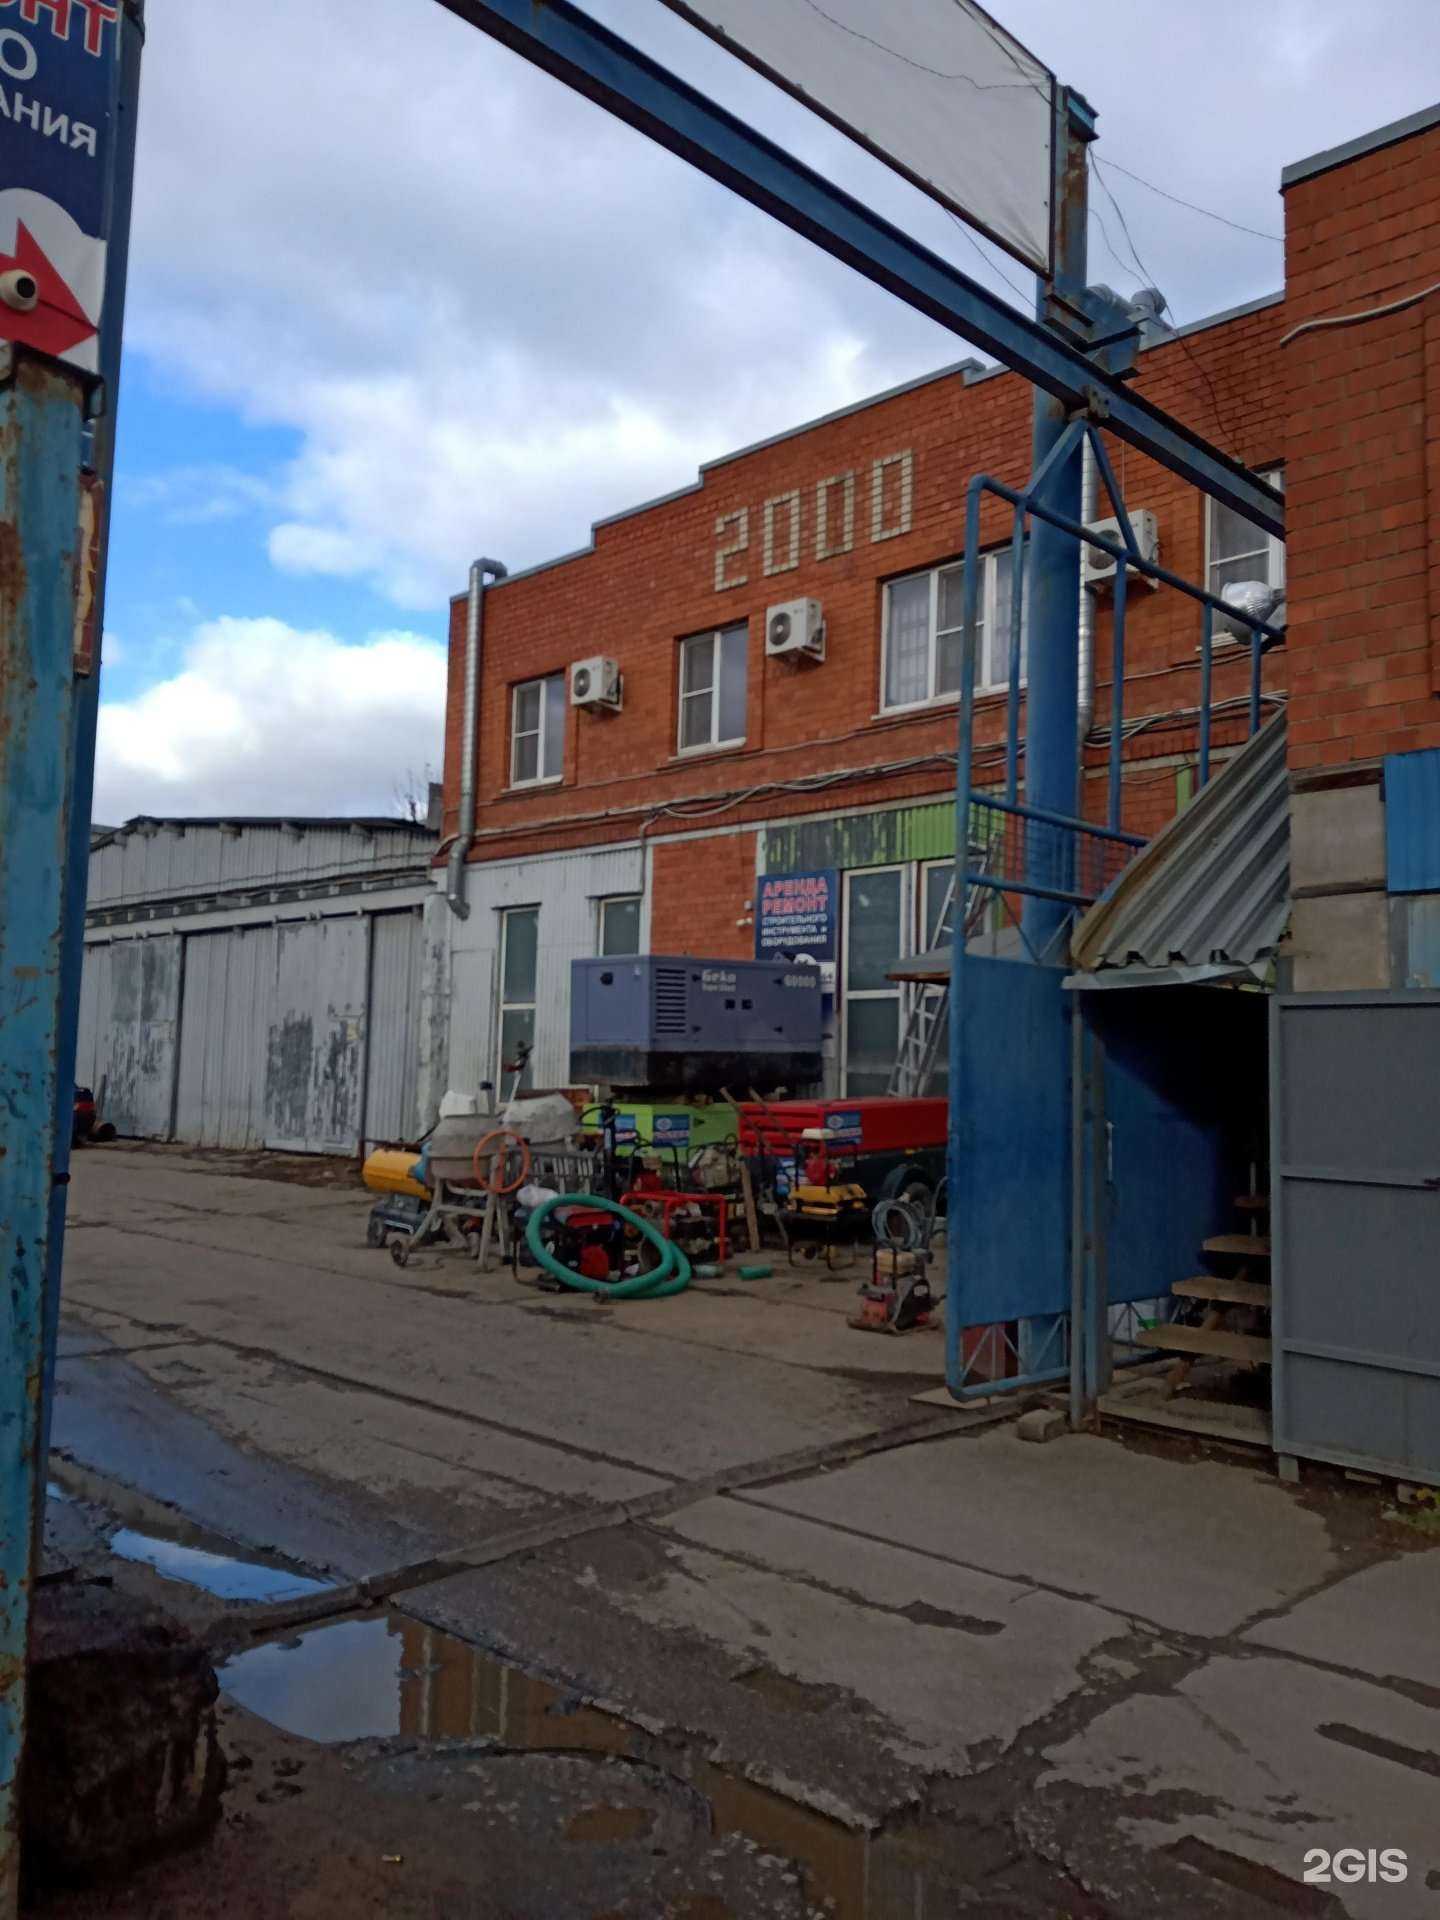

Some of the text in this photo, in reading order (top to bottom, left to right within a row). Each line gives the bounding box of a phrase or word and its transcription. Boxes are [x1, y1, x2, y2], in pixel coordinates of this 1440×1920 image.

[715, 447, 913, 592] 2000
[764, 877, 827, 897] АРЕНДА
[763, 896, 827, 915] РЕМОНТ
